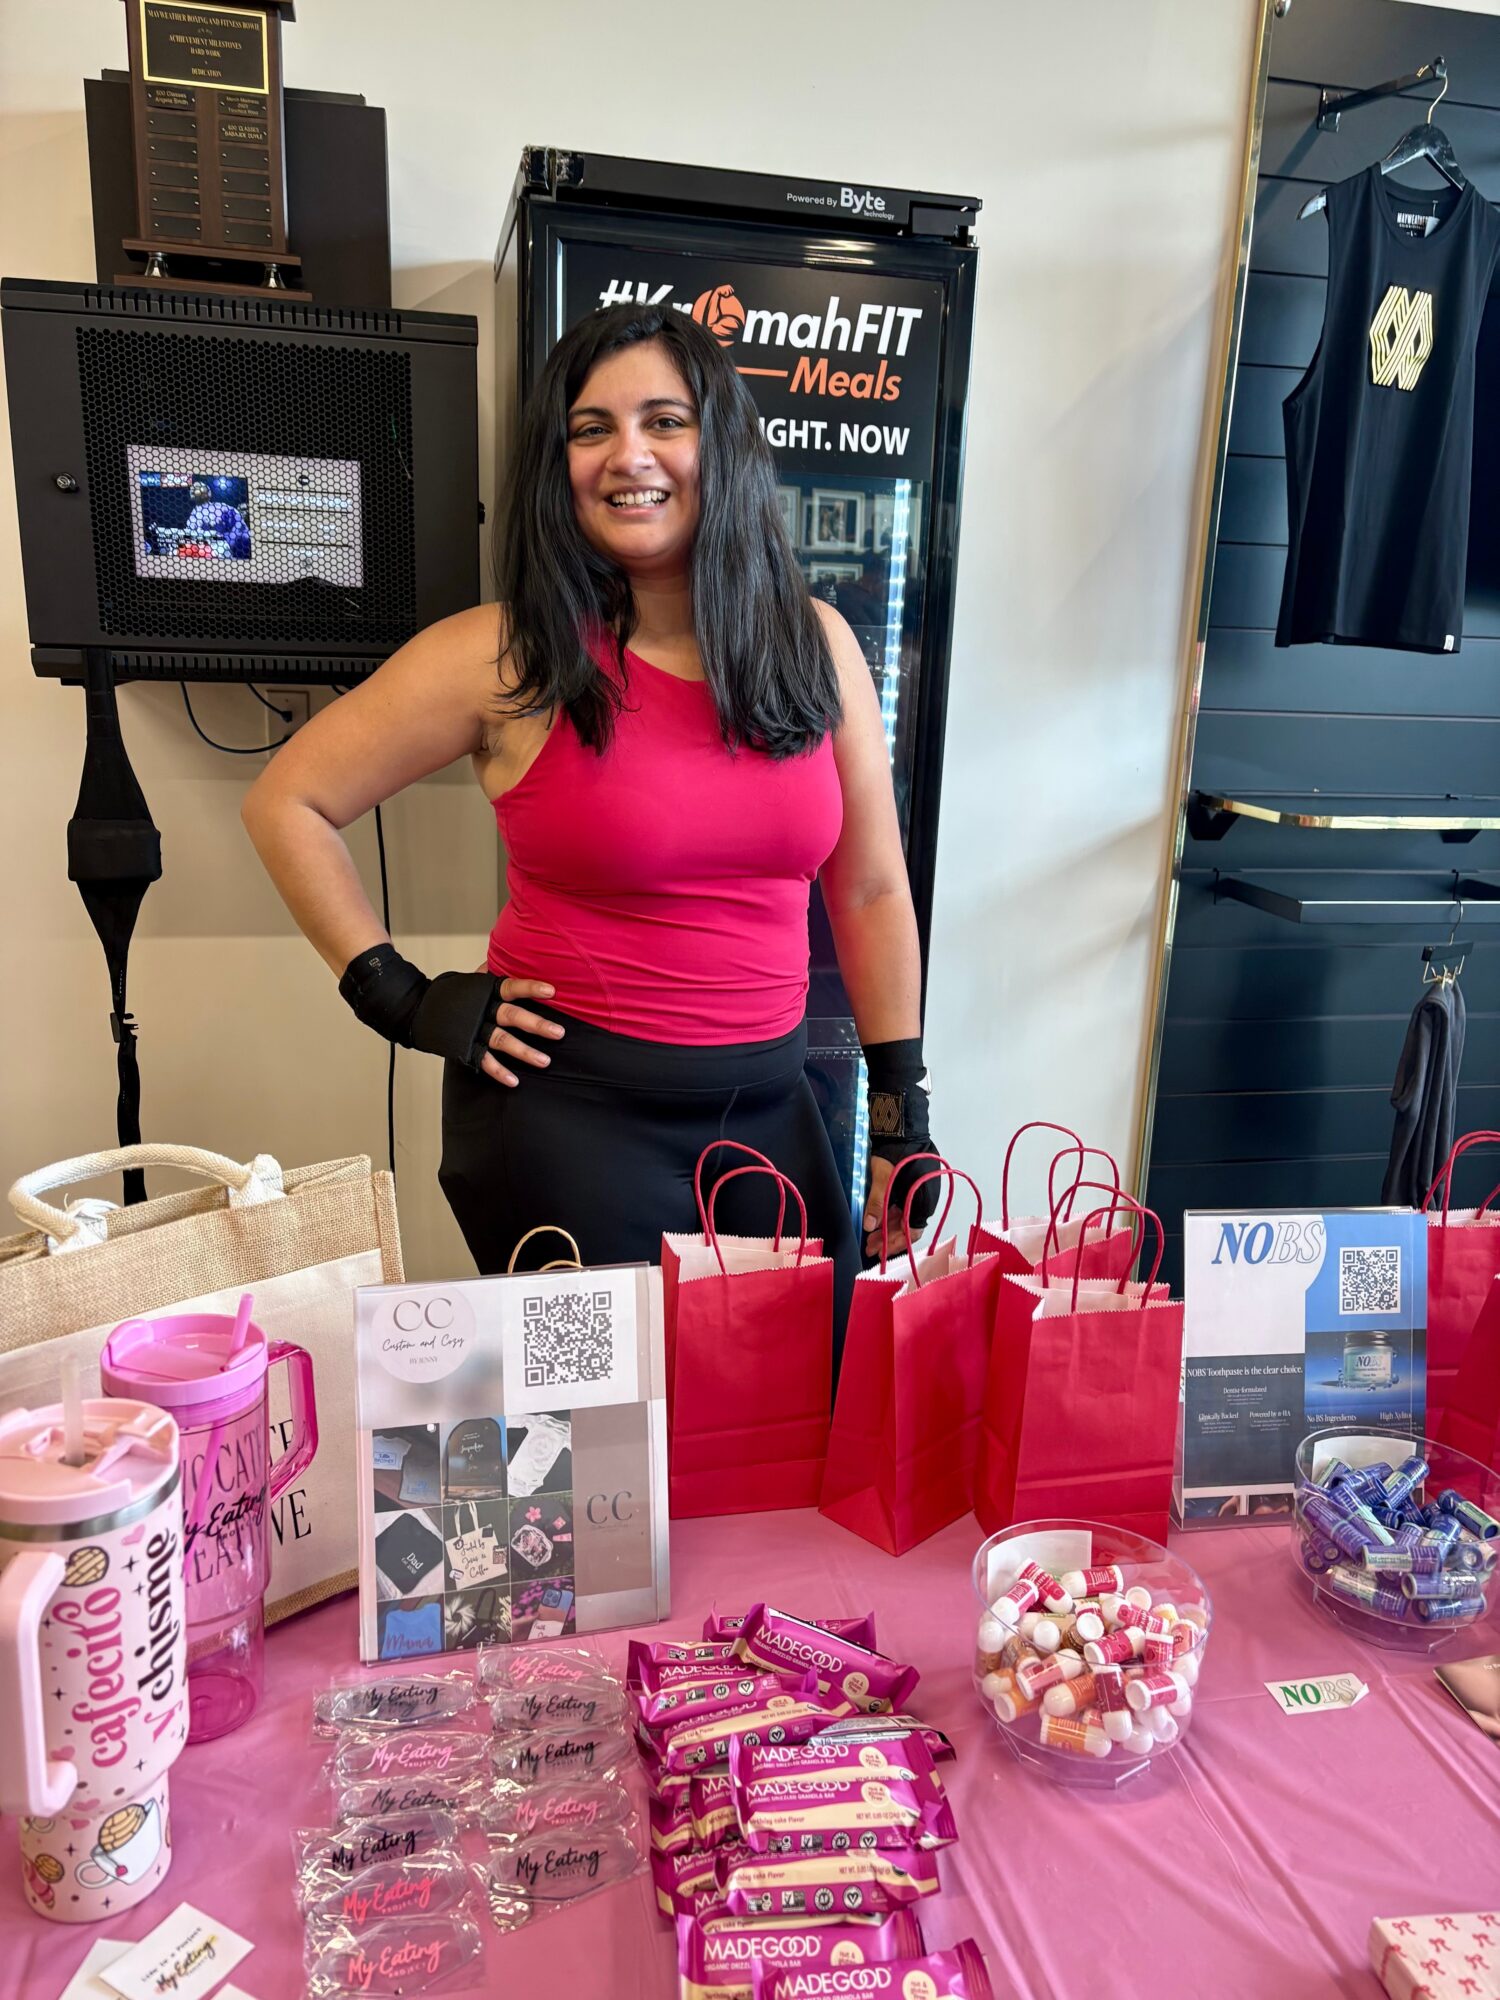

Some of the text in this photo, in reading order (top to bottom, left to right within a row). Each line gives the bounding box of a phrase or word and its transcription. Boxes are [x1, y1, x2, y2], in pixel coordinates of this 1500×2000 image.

[209, 18, 220, 26] AND
[786, 187, 886, 214] Powered By Byte
[863, 209, 895, 220] Technology
[789, 356, 902, 401] Meals
[839, 422, 910, 456] NOW
[1211, 1220, 1325, 1264] NOBS
[393, 1297, 454, 1332] CC
[382, 1333, 465, 1352] Custom and Cozy
[1207, 1367, 1244, 1378] Toothpaste
[1250, 1366, 1262, 1375] the
[1263, 1365, 1279, 1375] clear
[1280, 1365, 1303, 1375] choice.
[1325, 1414, 1357, 1424] Ingredients
[587, 1490, 632, 1524] CC
[407, 1552, 424, 1570] Dad
[135, 1528, 180, 1701] chisme
[386, 1633, 434, 1649] Mama
[756, 1624, 843, 1673] MADEGOOD
[52, 1587, 142, 1768] cafecito
[533, 1660, 591, 1682] Eating
[364, 1687, 386, 1709] My
[388, 1685, 445, 1704] Eating
[520, 1694, 601, 1721] My Eating
[1279, 1678, 1357, 1709] NOBS
[372, 1742, 456, 1772] My Eating
[519, 1740, 601, 1774] My Eating
[753, 1745, 850, 1766] MADEGOOD
[371, 1788, 397, 1814] My
[746, 1782, 850, 1799] MADEGOOD
[515, 1797, 605, 1830] My Eating
[788, 1816, 805, 1824] flavor
[332, 1829, 425, 1872] My Eating
[516, 1847, 608, 1886] My Eating
[767, 1871, 785, 1879] flavor
[342, 1874, 438, 1926] My Eating
[174, 1935, 218, 1977] Eating
[703, 1935, 821, 1962] MADEGOOD
[348, 1940, 450, 1991] My Eating
[731, 1961, 752, 1971] DRIZZL
[788, 1959, 801, 1967] BAR
[774, 1967, 891, 2000] MADEGOOD
